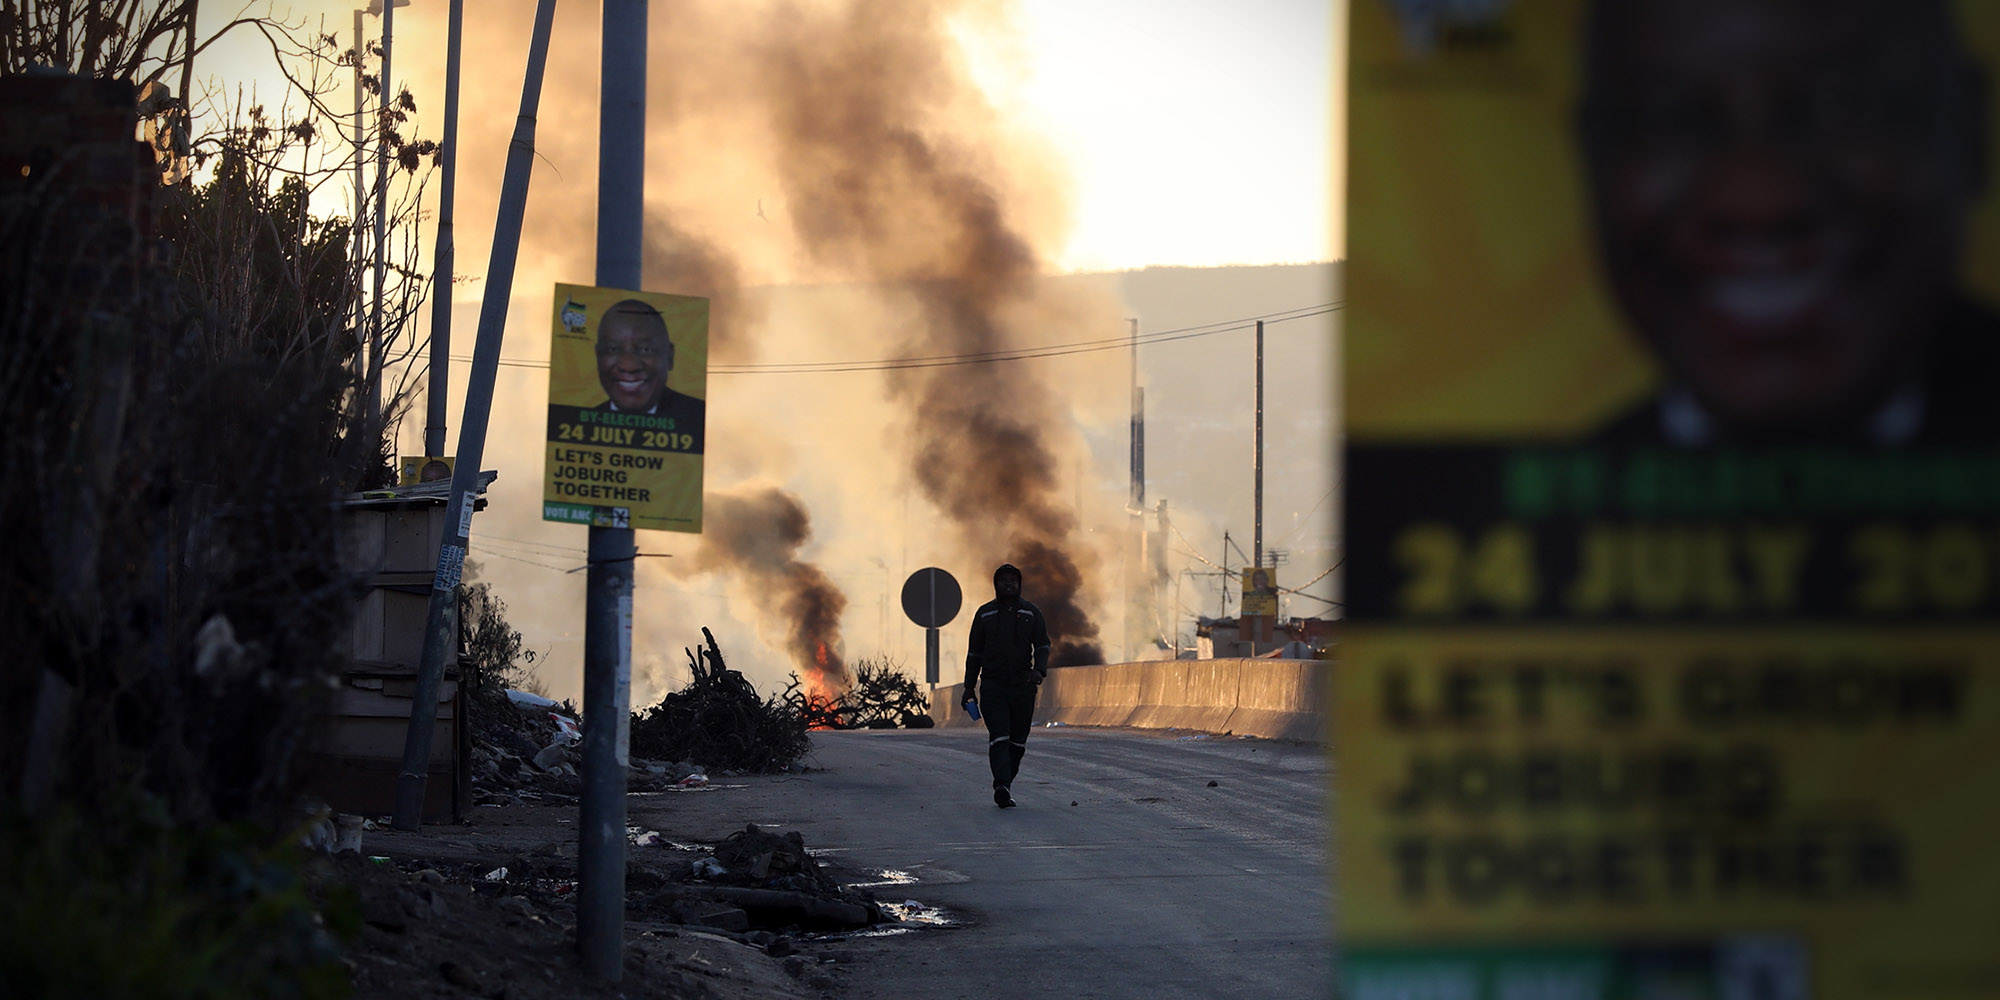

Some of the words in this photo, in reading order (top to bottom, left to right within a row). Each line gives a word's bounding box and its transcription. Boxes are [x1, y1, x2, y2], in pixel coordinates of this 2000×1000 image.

[580, 411, 676, 430] BY-ELECTIONS
[558, 424, 583, 441] 24
[590, 427, 635, 445] JULY
[642, 431, 693, 450] 2019
[555, 448, 602, 465] LET'S
[609, 454, 664, 470] GROW
[554, 465, 627, 483] JOBURG
[554, 482, 650, 502] TOGETHER
[545, 506, 568, 519] VOTE
[570, 508, 592, 521] ANC
[1391, 523, 1538, 612] 24
[1565, 522, 1810, 612] JULY
[1842, 525, 2000, 612] 20
[1681, 661, 1967, 731] GROW
